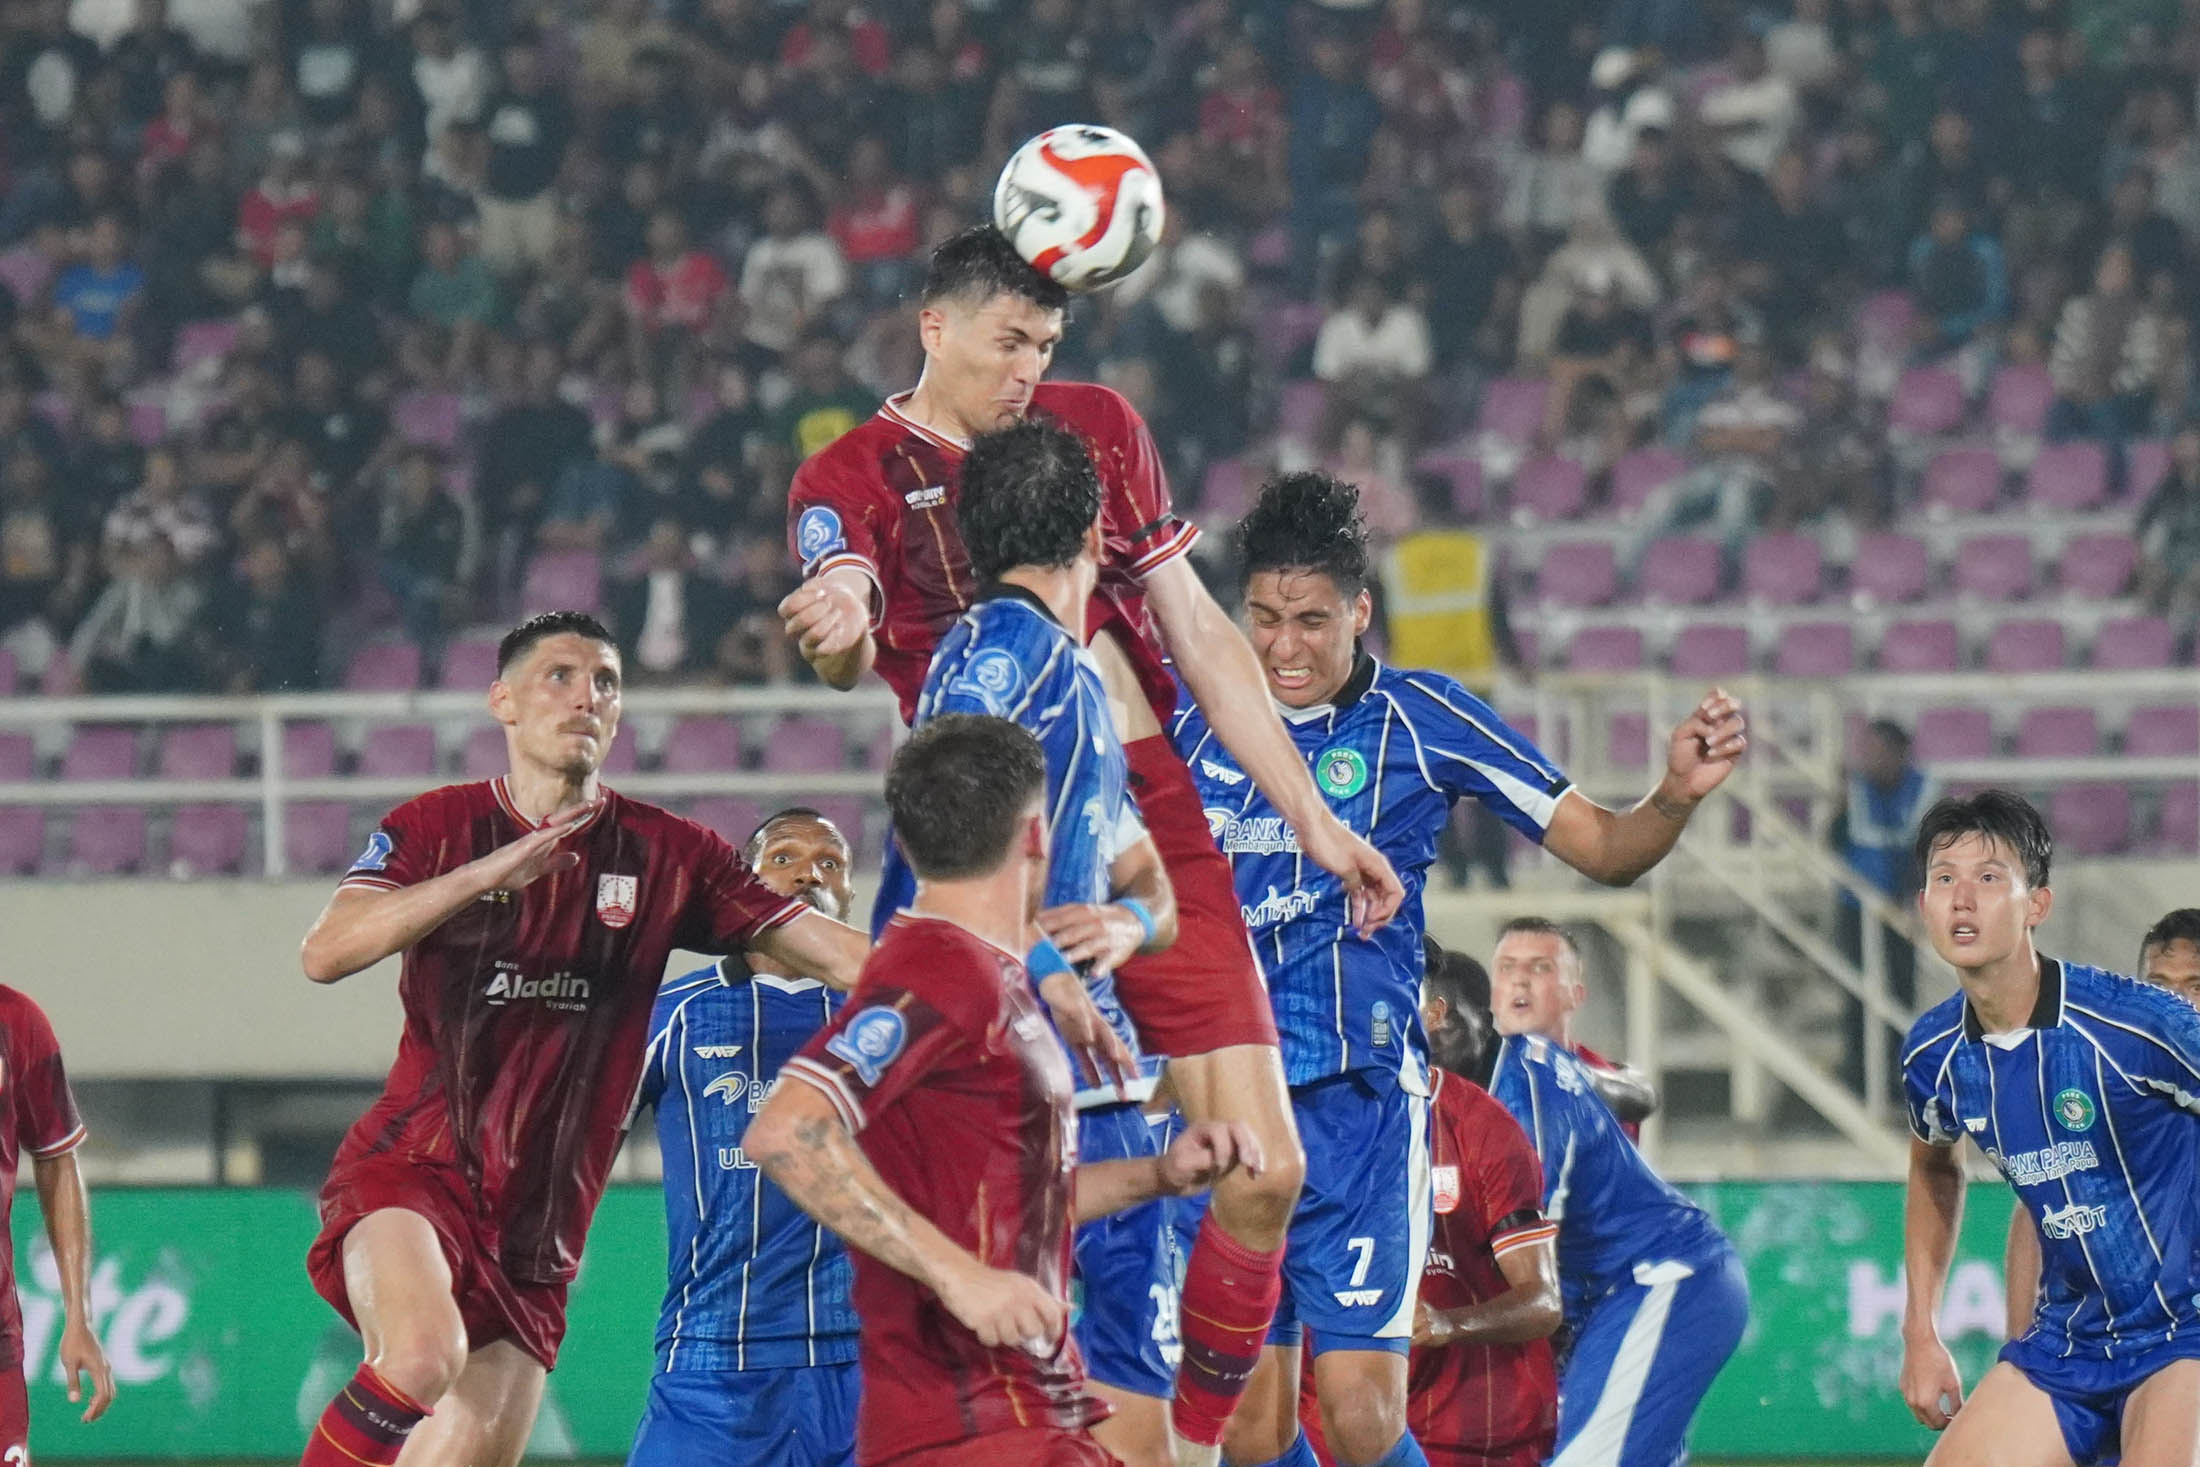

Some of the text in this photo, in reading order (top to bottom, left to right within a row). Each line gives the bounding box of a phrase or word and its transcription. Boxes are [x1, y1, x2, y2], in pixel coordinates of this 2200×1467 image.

[1225, 818, 1282, 840] BANK
[1223, 840, 1284, 855] Membangun
[485, 971, 590, 999] Aladin
[719, 1148, 759, 1170] UL
[2040, 1141, 2096, 1170] PAPUA
[2015, 1171, 2047, 1186] bangun
[1347, 1236, 1375, 1288] 7
[1850, 1260, 2007, 1338] HA
